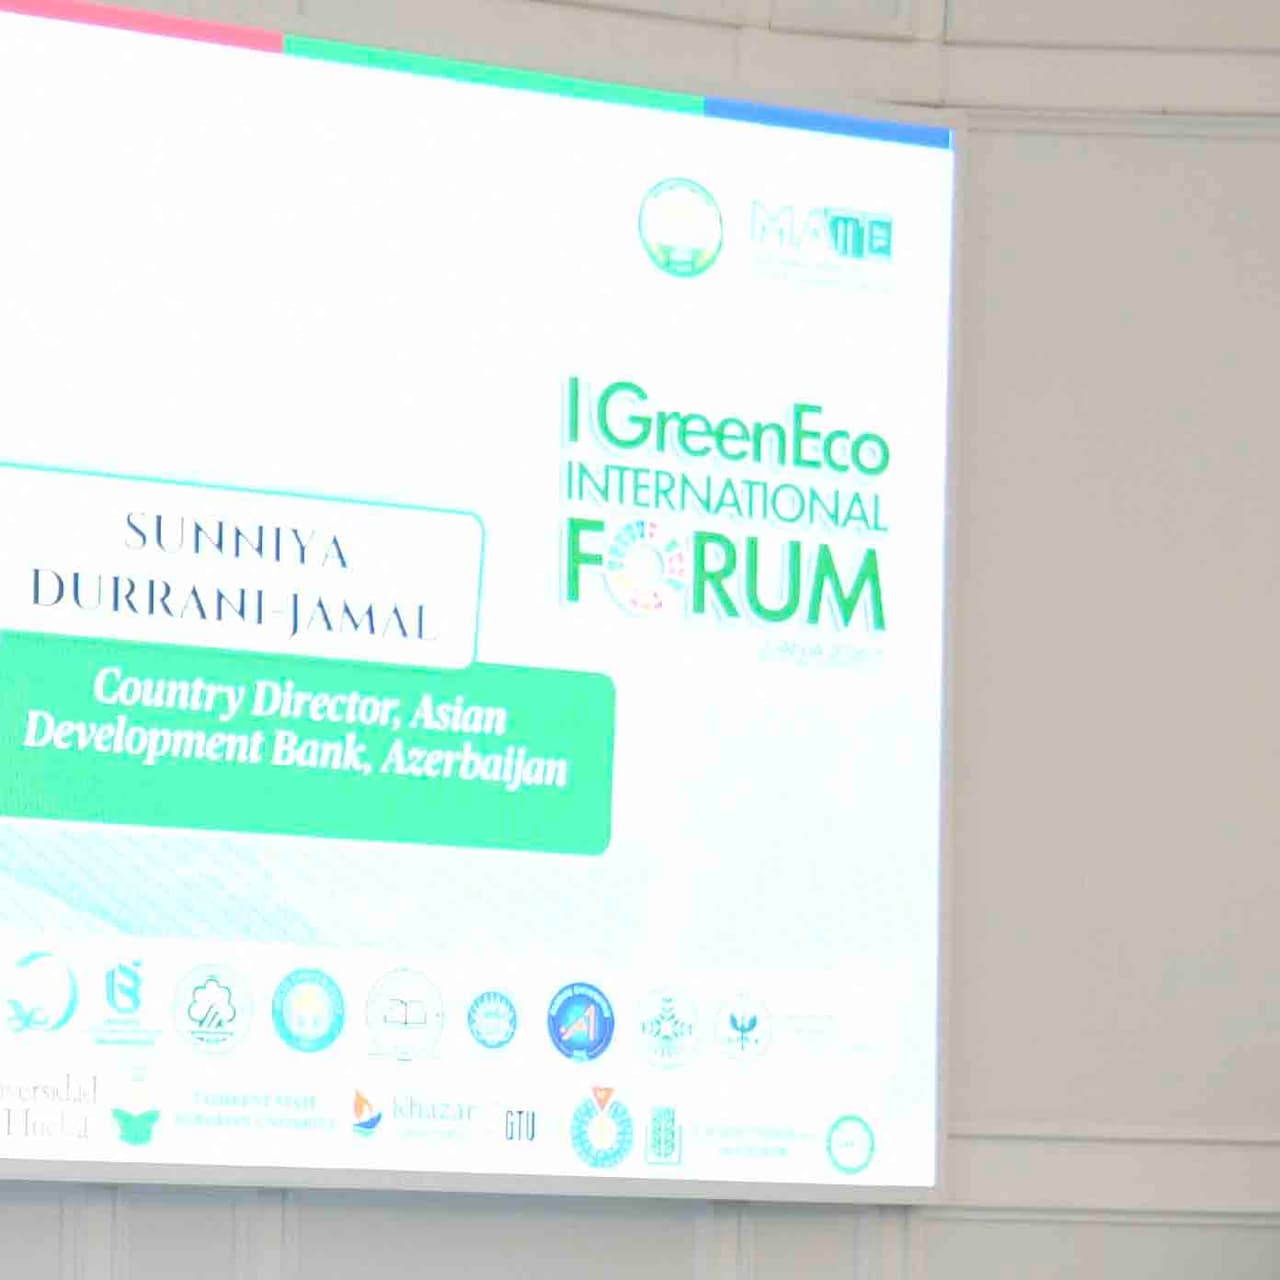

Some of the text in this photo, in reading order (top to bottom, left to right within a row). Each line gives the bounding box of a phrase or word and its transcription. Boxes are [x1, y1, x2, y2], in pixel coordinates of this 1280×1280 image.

[596, 380, 890, 476] GreenEco
[566, 460, 889, 533] INTERNATIONAL
[125, 511, 350, 570] SUNNIYA
[565, 516, 887, 632] FORUM
[31, 566, 438, 641] DURRANI-JAMAL
[92, 665, 508, 738] Country Director, Asian
[21, 709, 570, 793] Development Bank, Azerbaijan
[504, 1110, 535, 1142] GTU
